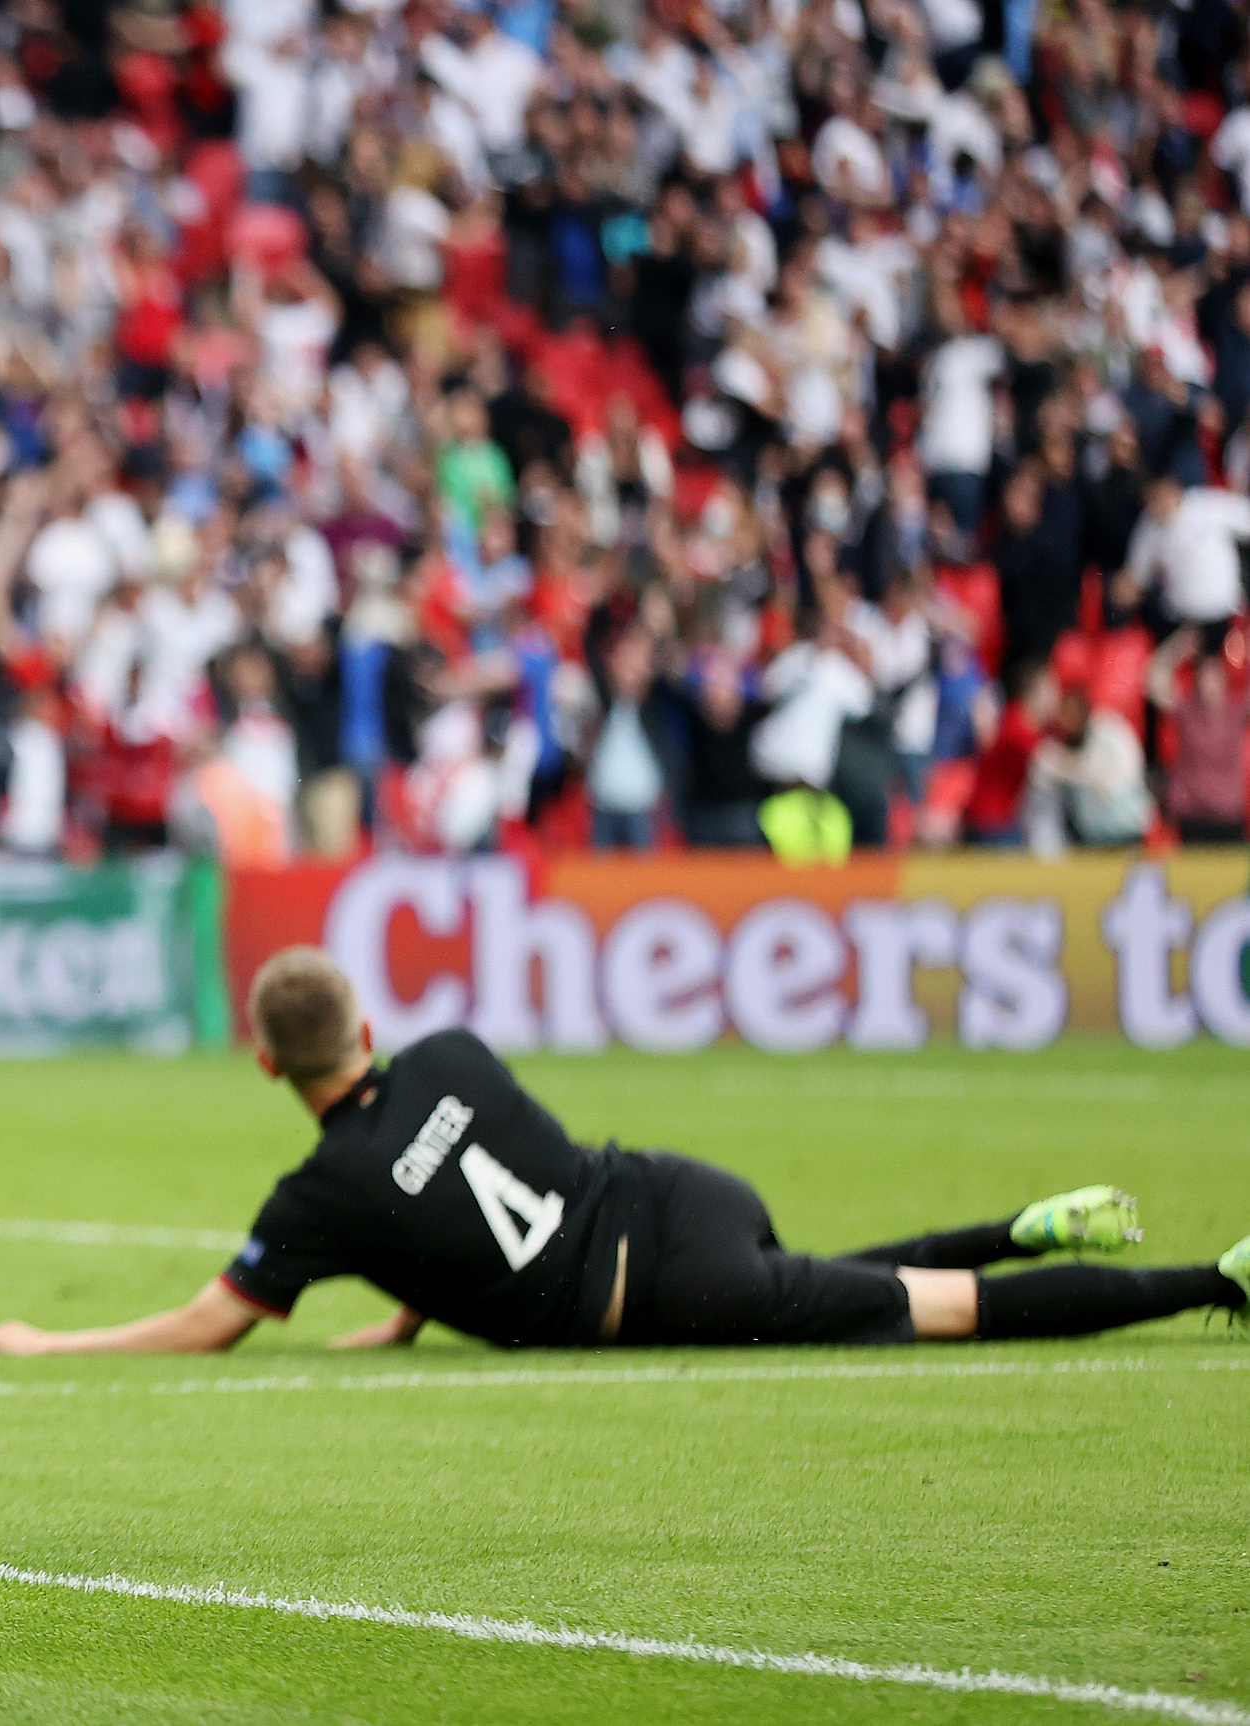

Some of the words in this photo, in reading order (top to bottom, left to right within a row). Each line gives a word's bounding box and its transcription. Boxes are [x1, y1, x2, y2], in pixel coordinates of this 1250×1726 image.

[324, 853, 1065, 1052] Cheers
[392, 1095, 475, 1195] GINTER
[459, 1142, 565, 1272] 4
